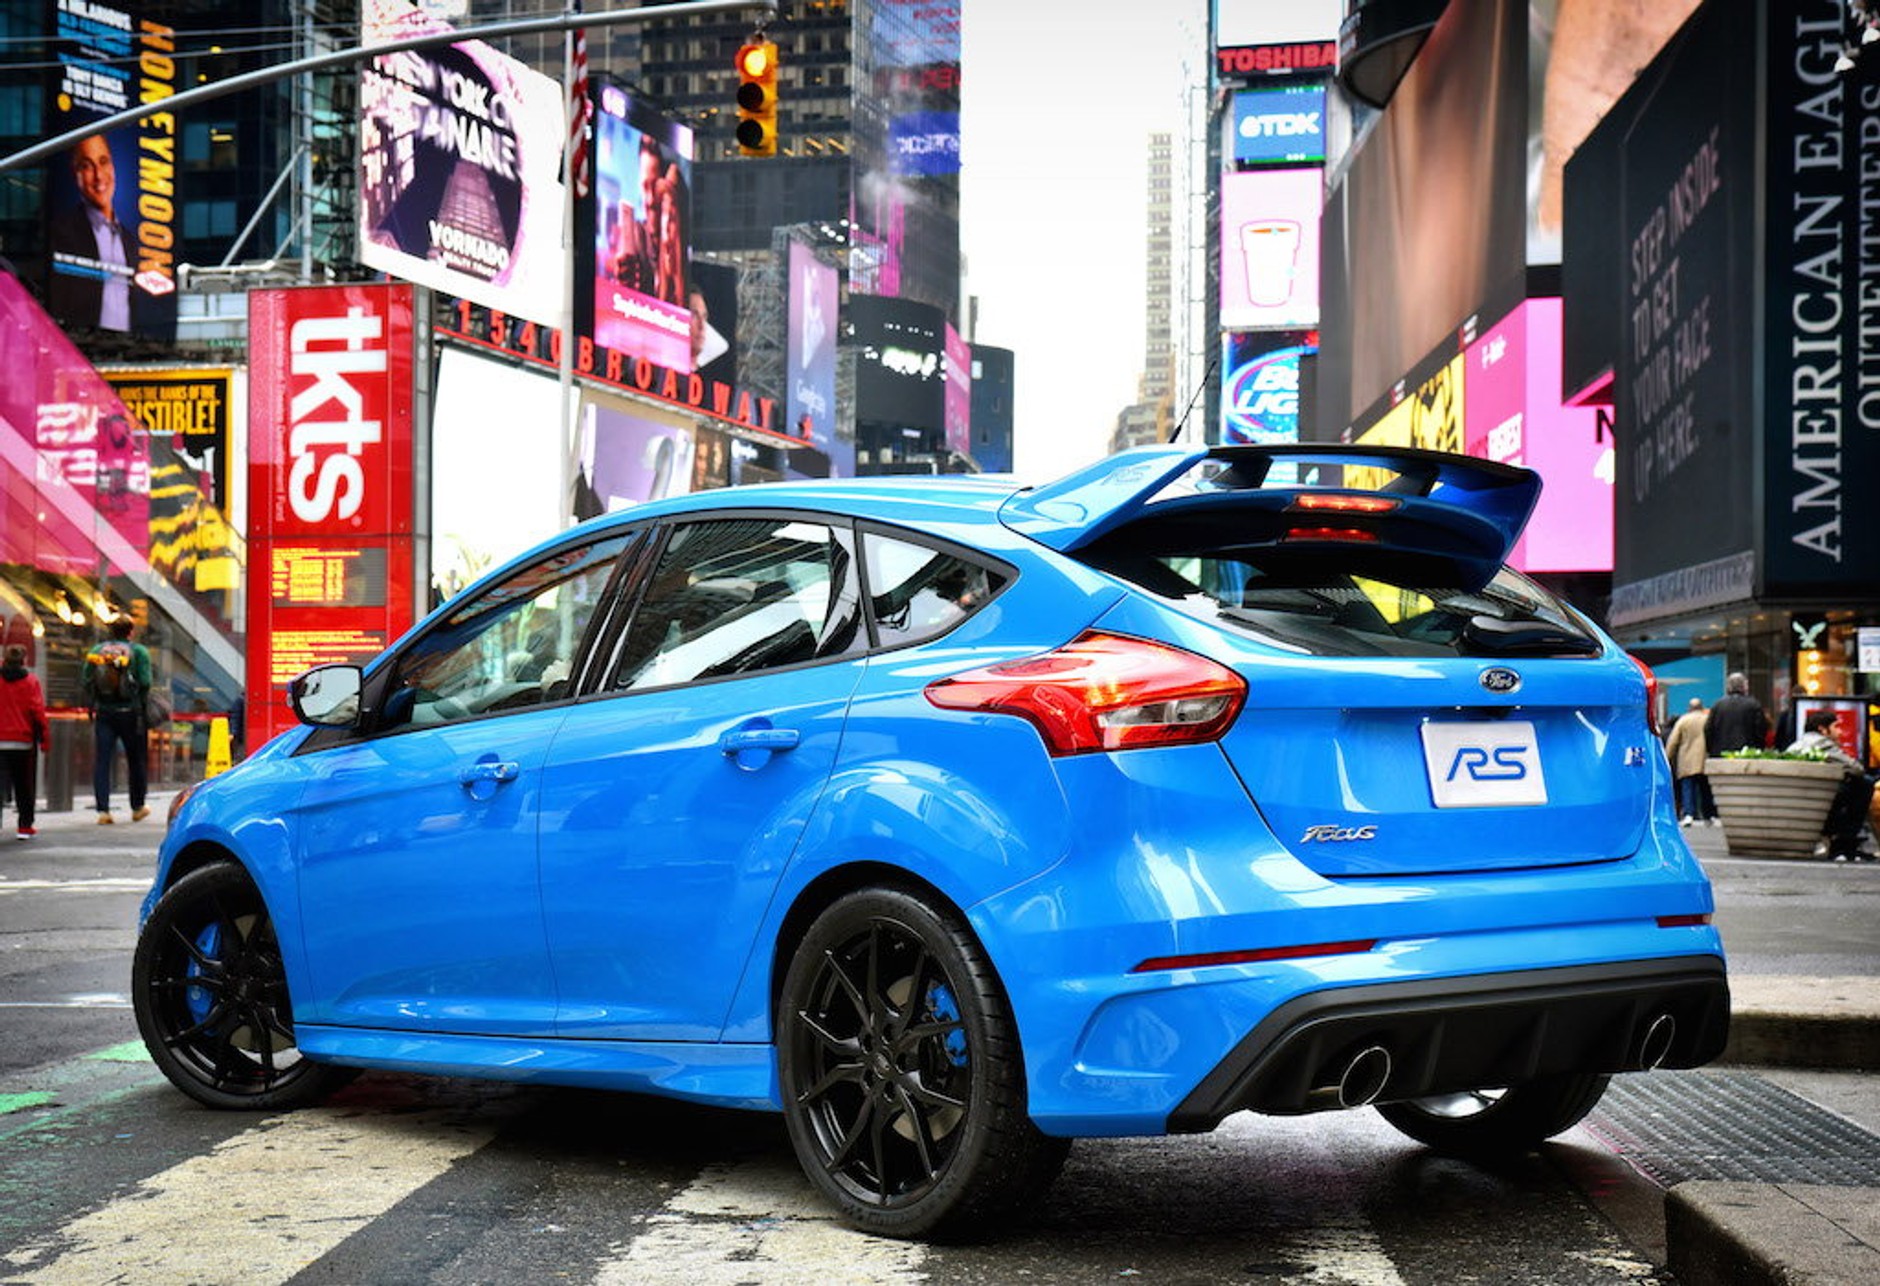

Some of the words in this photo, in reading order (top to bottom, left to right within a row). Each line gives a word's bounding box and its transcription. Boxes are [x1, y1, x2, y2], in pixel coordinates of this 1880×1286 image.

[1217, 42, 1336, 72] TOSHIBA
[139, 19, 176, 278] HONEYMOON
[1258, 112, 1320, 137] TDK
[1632, 205, 1666, 297] STEP
[1669, 123, 1720, 248] INSIDE
[1633, 297, 1650, 365] TO
[1652, 256, 1679, 341] GET
[577, 335, 774, 430] BROADWAY
[1633, 344, 1671, 432] YOUR
[1674, 294, 1711, 389] FACE
[1792, 193, 1843, 562] AMERICAN
[289, 306, 387, 523] tkts
[1635, 437, 1653, 502] UP
[1446, 745, 1528, 782] RS
[1299, 823, 1378, 844] Focus
